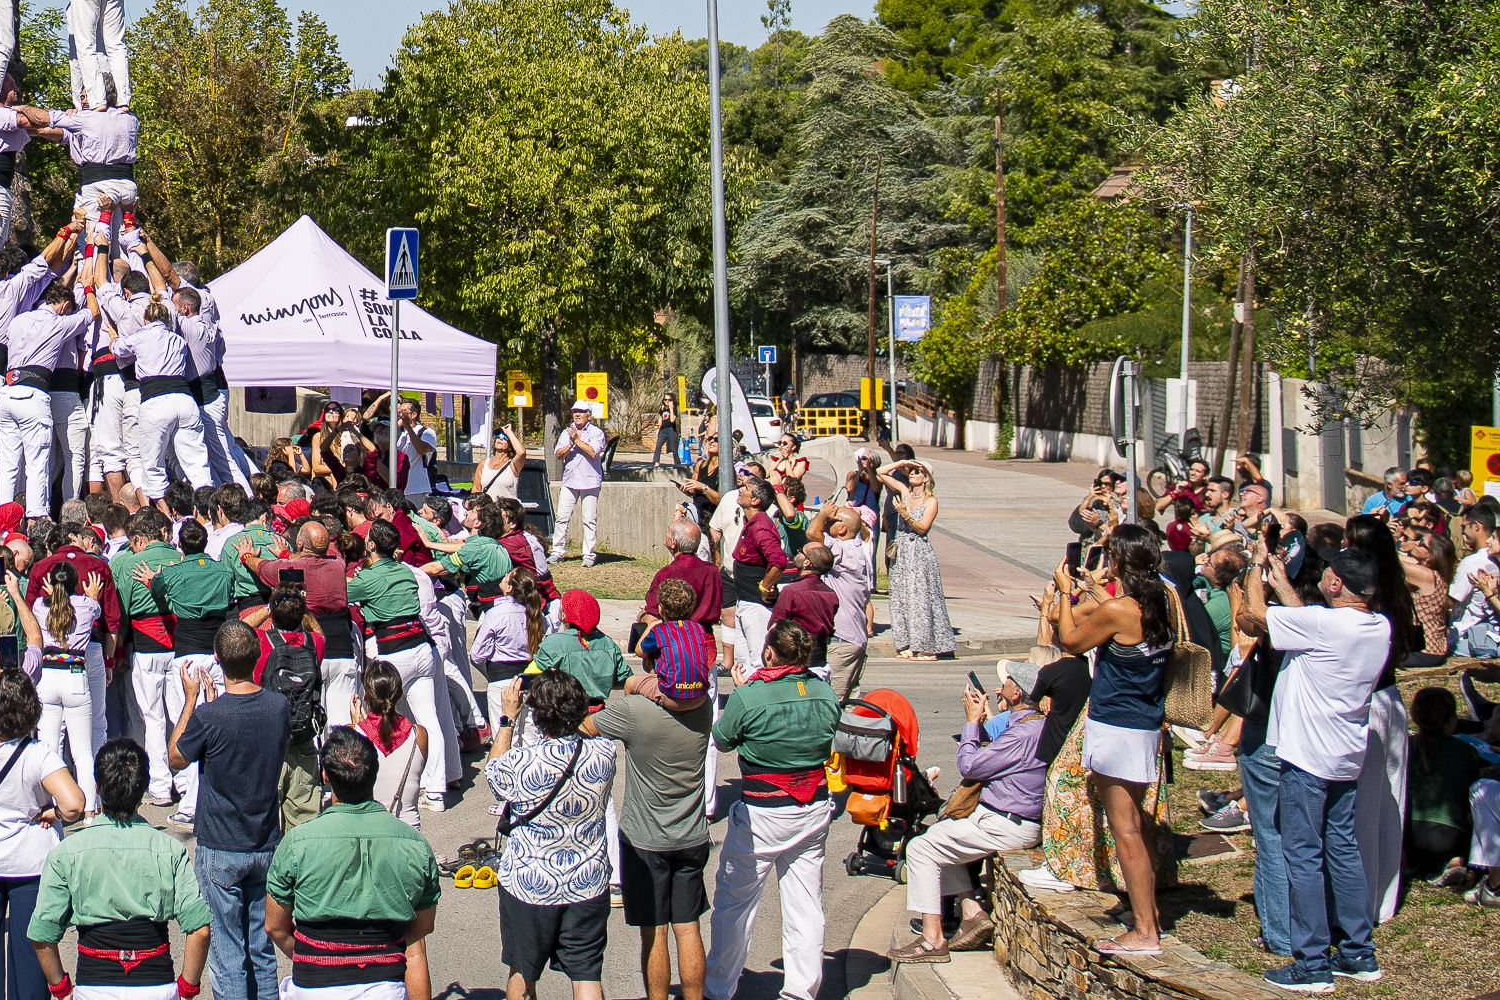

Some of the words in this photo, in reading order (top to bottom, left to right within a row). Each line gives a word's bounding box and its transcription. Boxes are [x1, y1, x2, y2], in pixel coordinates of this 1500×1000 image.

[318, 311, 348, 319] Terrassa
[366, 314, 389, 327] LA
[372, 327, 423, 340] COLA
[675, 681, 696, 690] unicef
